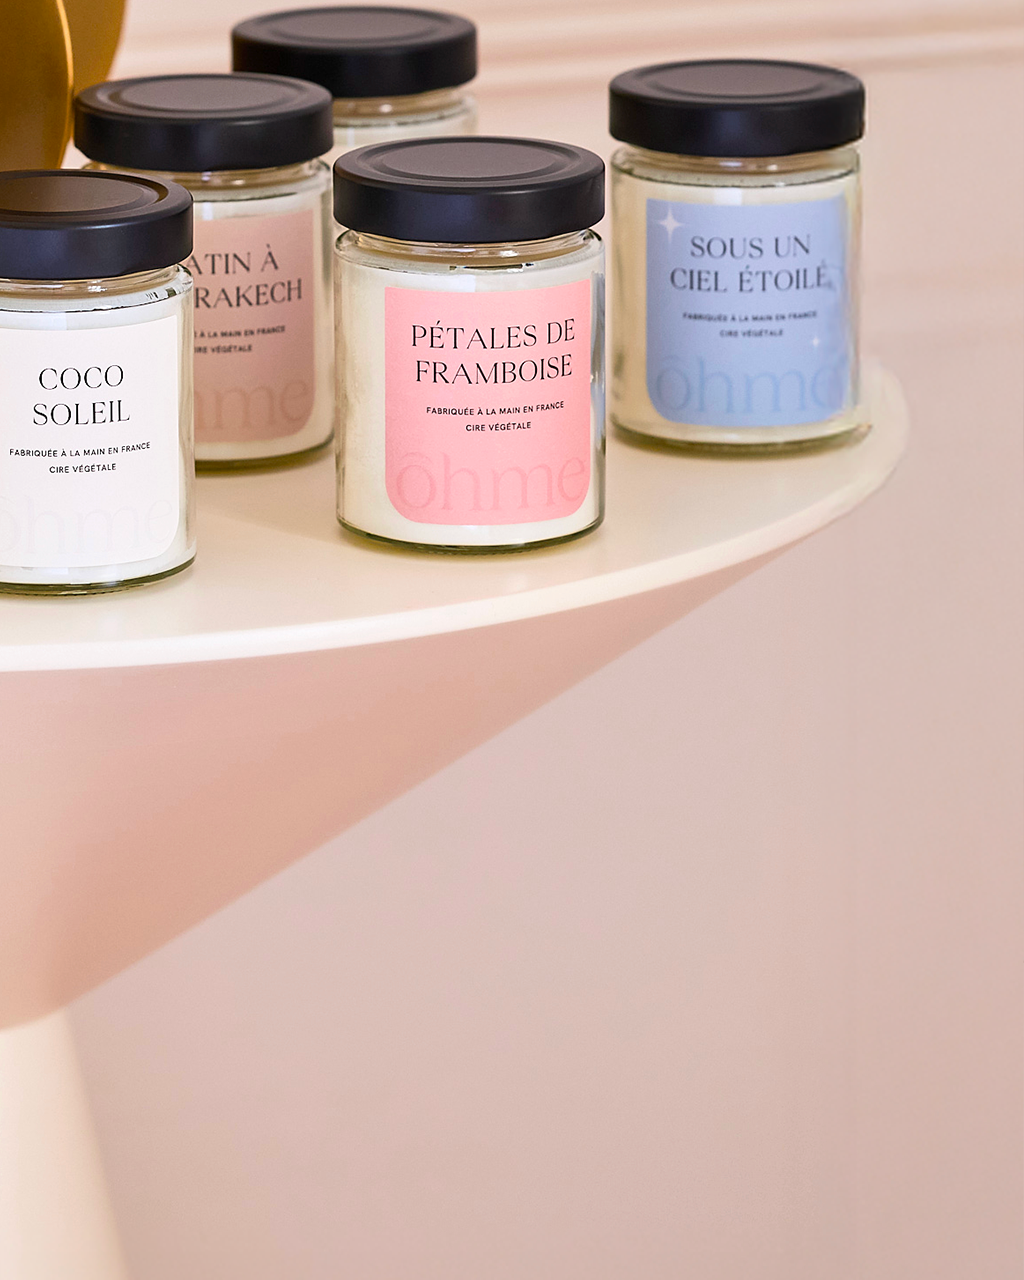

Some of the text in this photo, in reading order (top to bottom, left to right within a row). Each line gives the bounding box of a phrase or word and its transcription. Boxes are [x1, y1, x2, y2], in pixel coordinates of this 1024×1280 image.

[187, 244, 279, 275] ATIN À
[690, 234, 810, 260] SOUS UN
[670, 267, 727, 292] CIEL
[195, 278, 302, 309] RAKECH
[731, 313, 736, 321] À
[739, 313, 749, 321] LA
[752, 313, 773, 321] MAIN
[775, 312, 786, 320] EN
[788, 310, 817, 319] FRANCE
[200, 328, 205, 338] À
[208, 330, 218, 338] LA
[221, 329, 242, 337] MAIN
[244, 327, 255, 336] EN
[257, 325, 286, 335] FRANCE
[412, 318, 575, 349] PÉTALES DE
[720, 329, 738, 337] CIRE
[195, 344, 252, 354] IRE VÉGÉTALE
[39, 364, 124, 390] COCO
[416, 354, 572, 384] FRAMBOISE
[33, 400, 130, 426] SOLEIL
[195, 381, 307, 430] me
[426, 407, 474, 416] FABRIQUÉE
[477, 407, 483, 415] À
[500, 407, 521, 415] MAIN
[536, 401, 564, 412] FRANCE
[489, 422, 532, 431] VÉGÉTALE
[10, 448, 58, 457] FABRIQUÉE
[61, 448, 67, 457] À
[84, 448, 105, 456] MAIN
[122, 442, 151, 453] FRANCE
[49, 463, 116, 474] CIRE VÉGÉTALE
